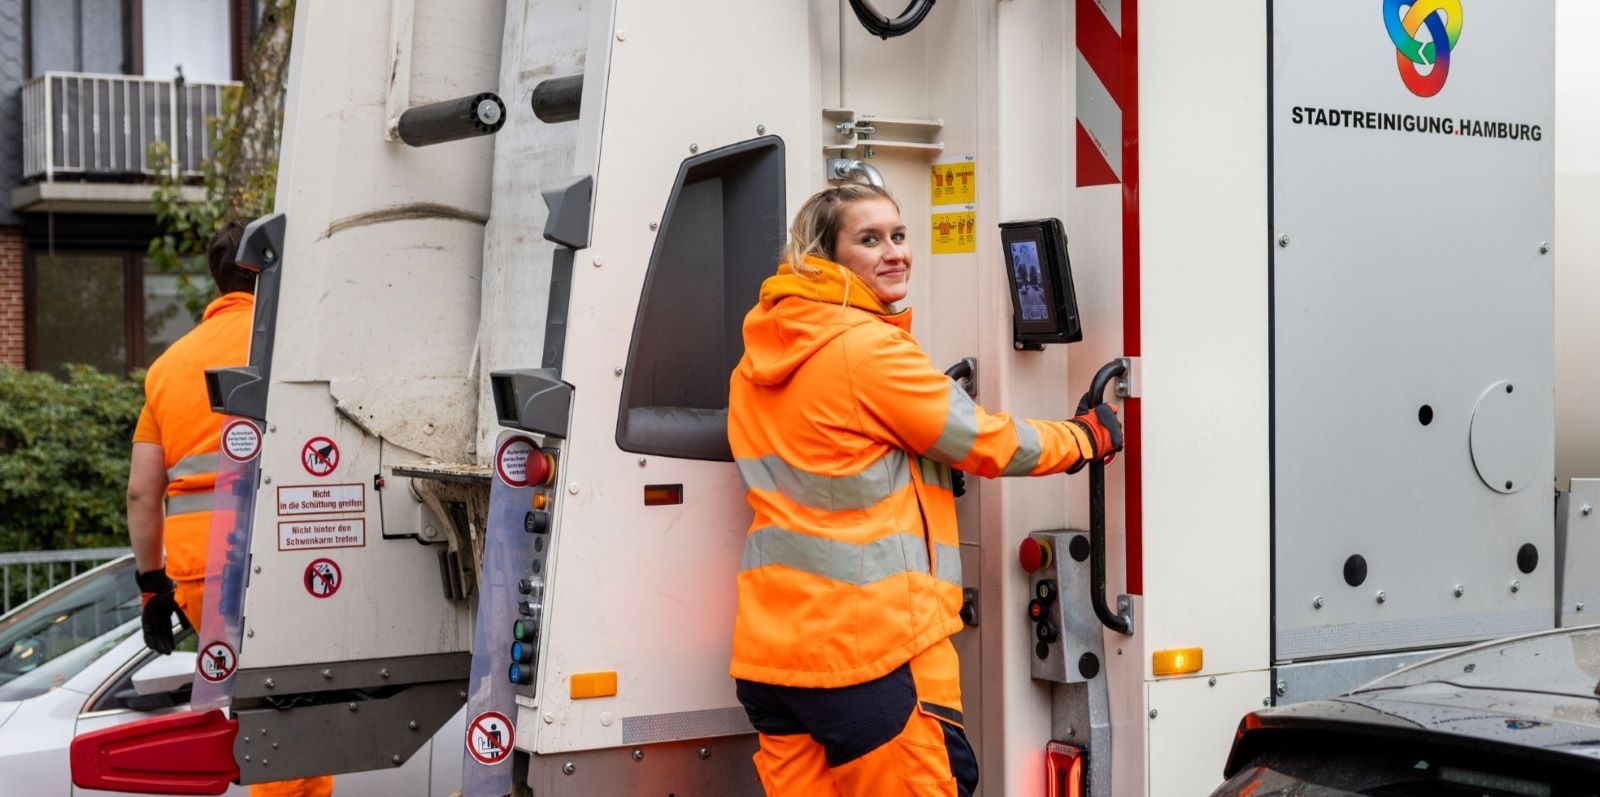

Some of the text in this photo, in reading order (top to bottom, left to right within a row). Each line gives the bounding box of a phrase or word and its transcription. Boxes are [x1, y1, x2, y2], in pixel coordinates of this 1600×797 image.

[1291, 106, 1542, 142] STADTREINIGUNG.HAMBURG
[312, 490, 331, 498] Nicht
[289, 501, 300, 509] die
[301, 500, 336, 509] Schüttung
[338, 499, 362, 508] greifen
[292, 524, 352, 534] Nicht hinter den
[286, 535, 358, 546] Schwenkarm treten
